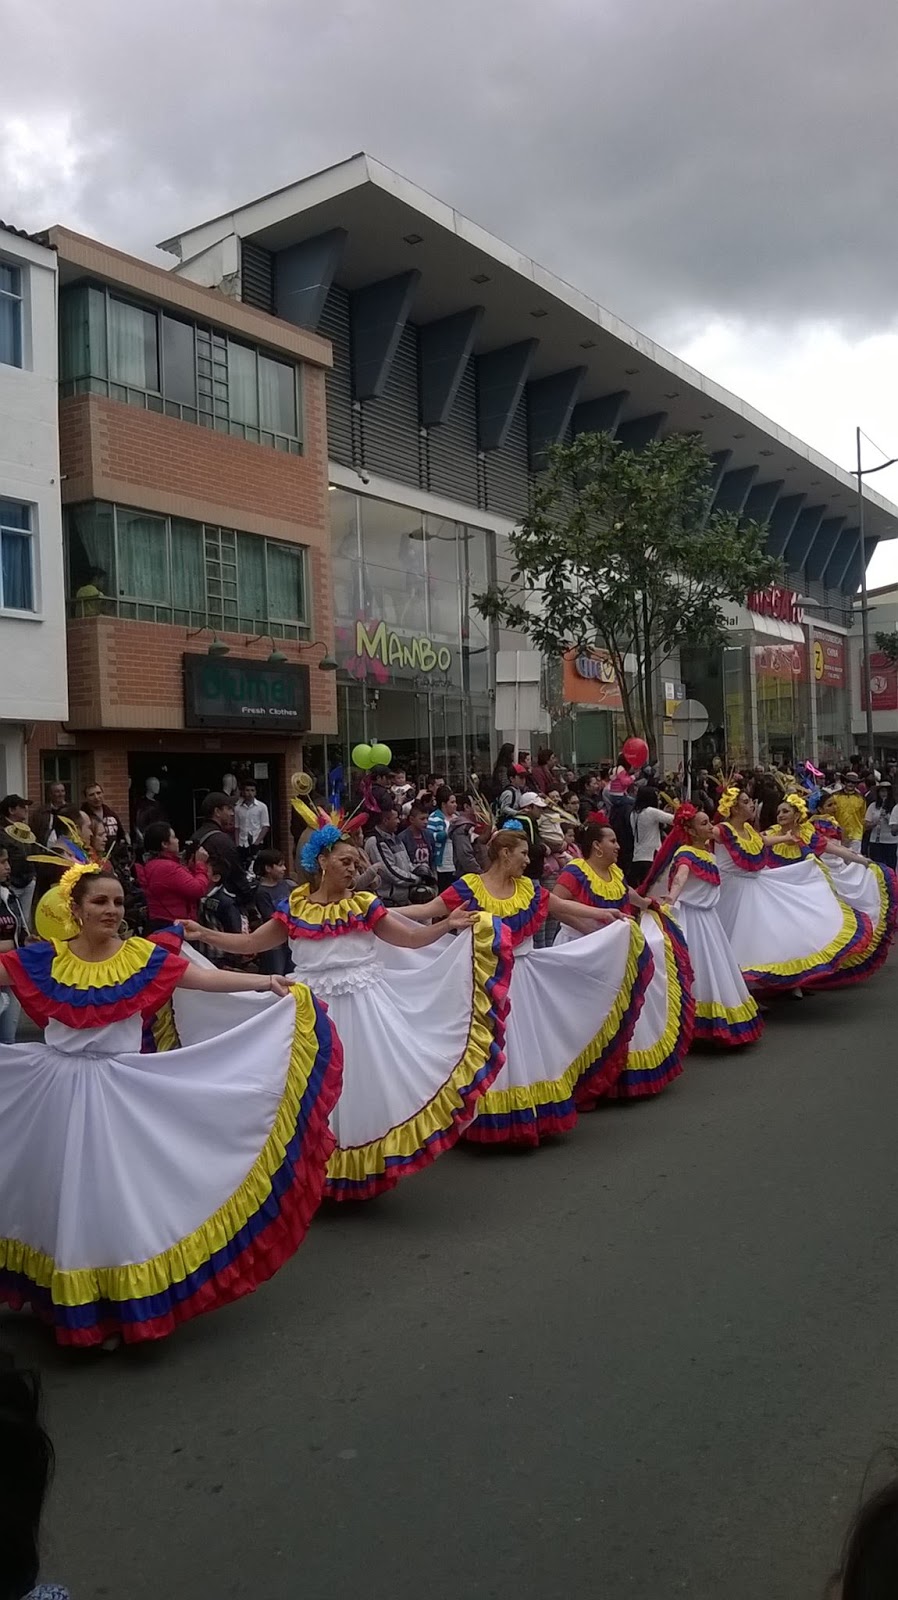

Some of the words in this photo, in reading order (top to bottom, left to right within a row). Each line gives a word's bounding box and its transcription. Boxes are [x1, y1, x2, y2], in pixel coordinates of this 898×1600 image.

[355, 620, 452, 672] MAMBO
[241, 706, 266, 714] Fresh
[269, 708, 298, 716] Clothes
